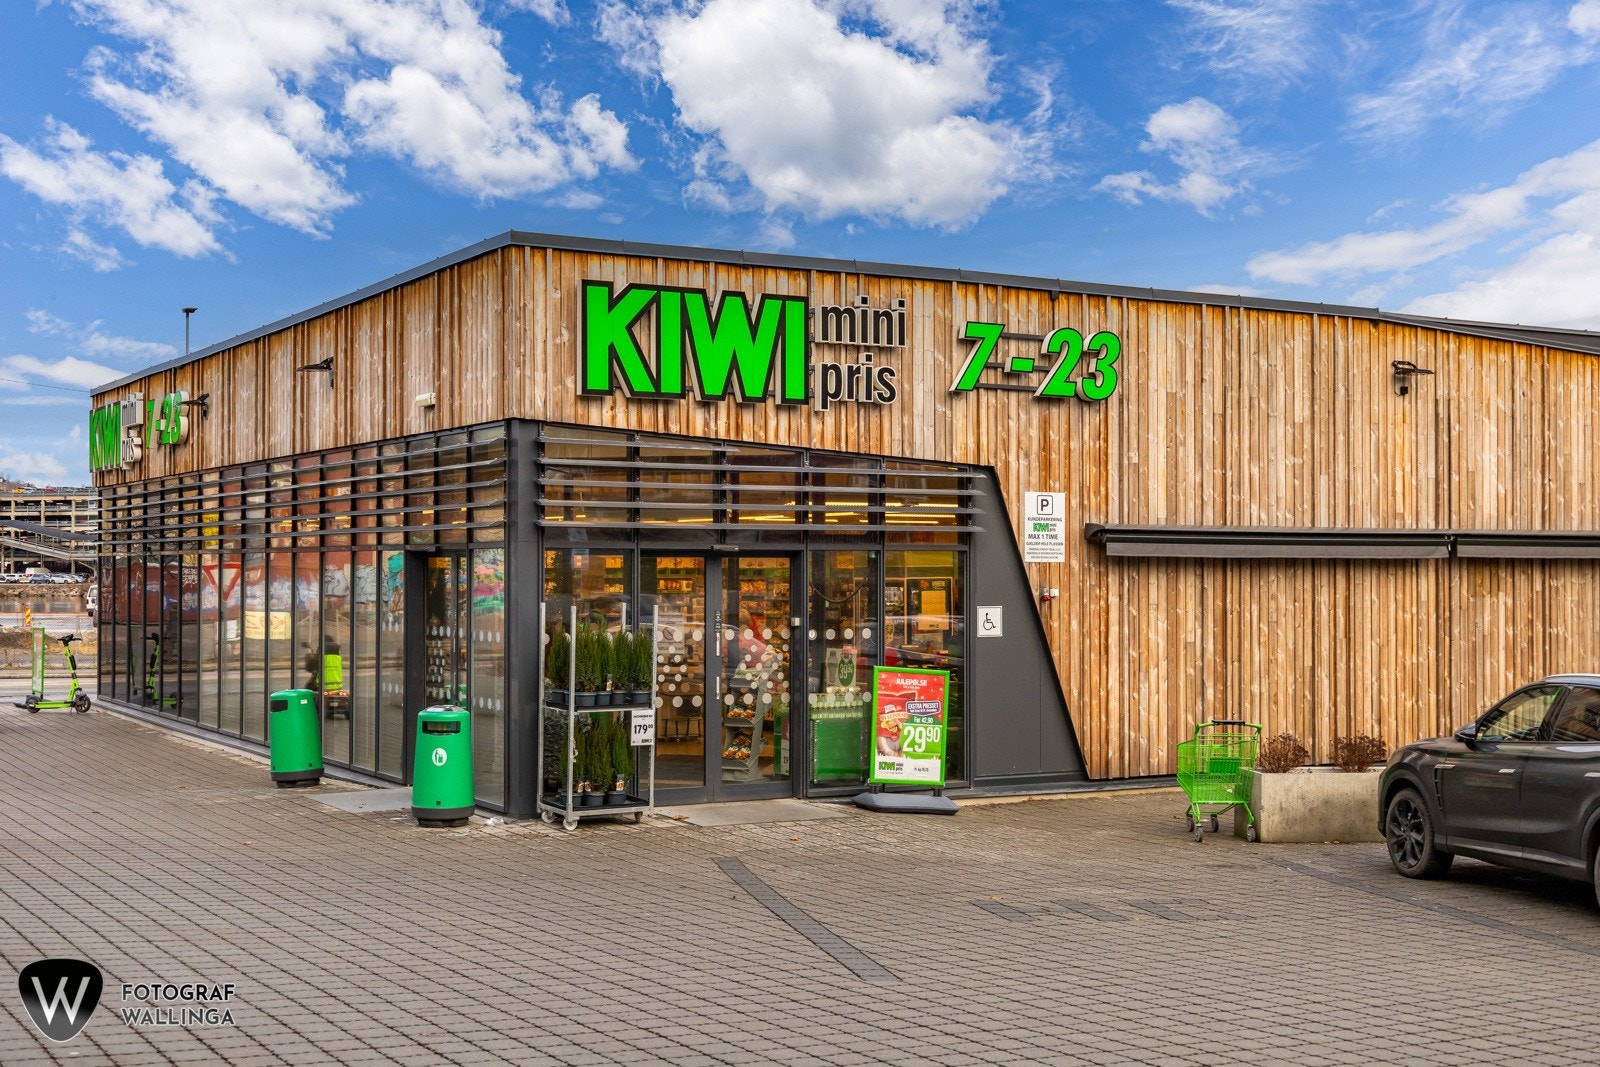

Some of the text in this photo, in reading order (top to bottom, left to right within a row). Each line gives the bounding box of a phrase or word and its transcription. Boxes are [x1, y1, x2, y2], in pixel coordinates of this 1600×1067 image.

[578, 279, 906, 405] KIWI mini
[816, 352, 897, 411] pris
[90, 401, 122, 472] KIWI
[1041, 499, 1049, 511] P
[896, 678, 928, 687] JULEPØLSE
[878, 761, 895, 771] KIWI
